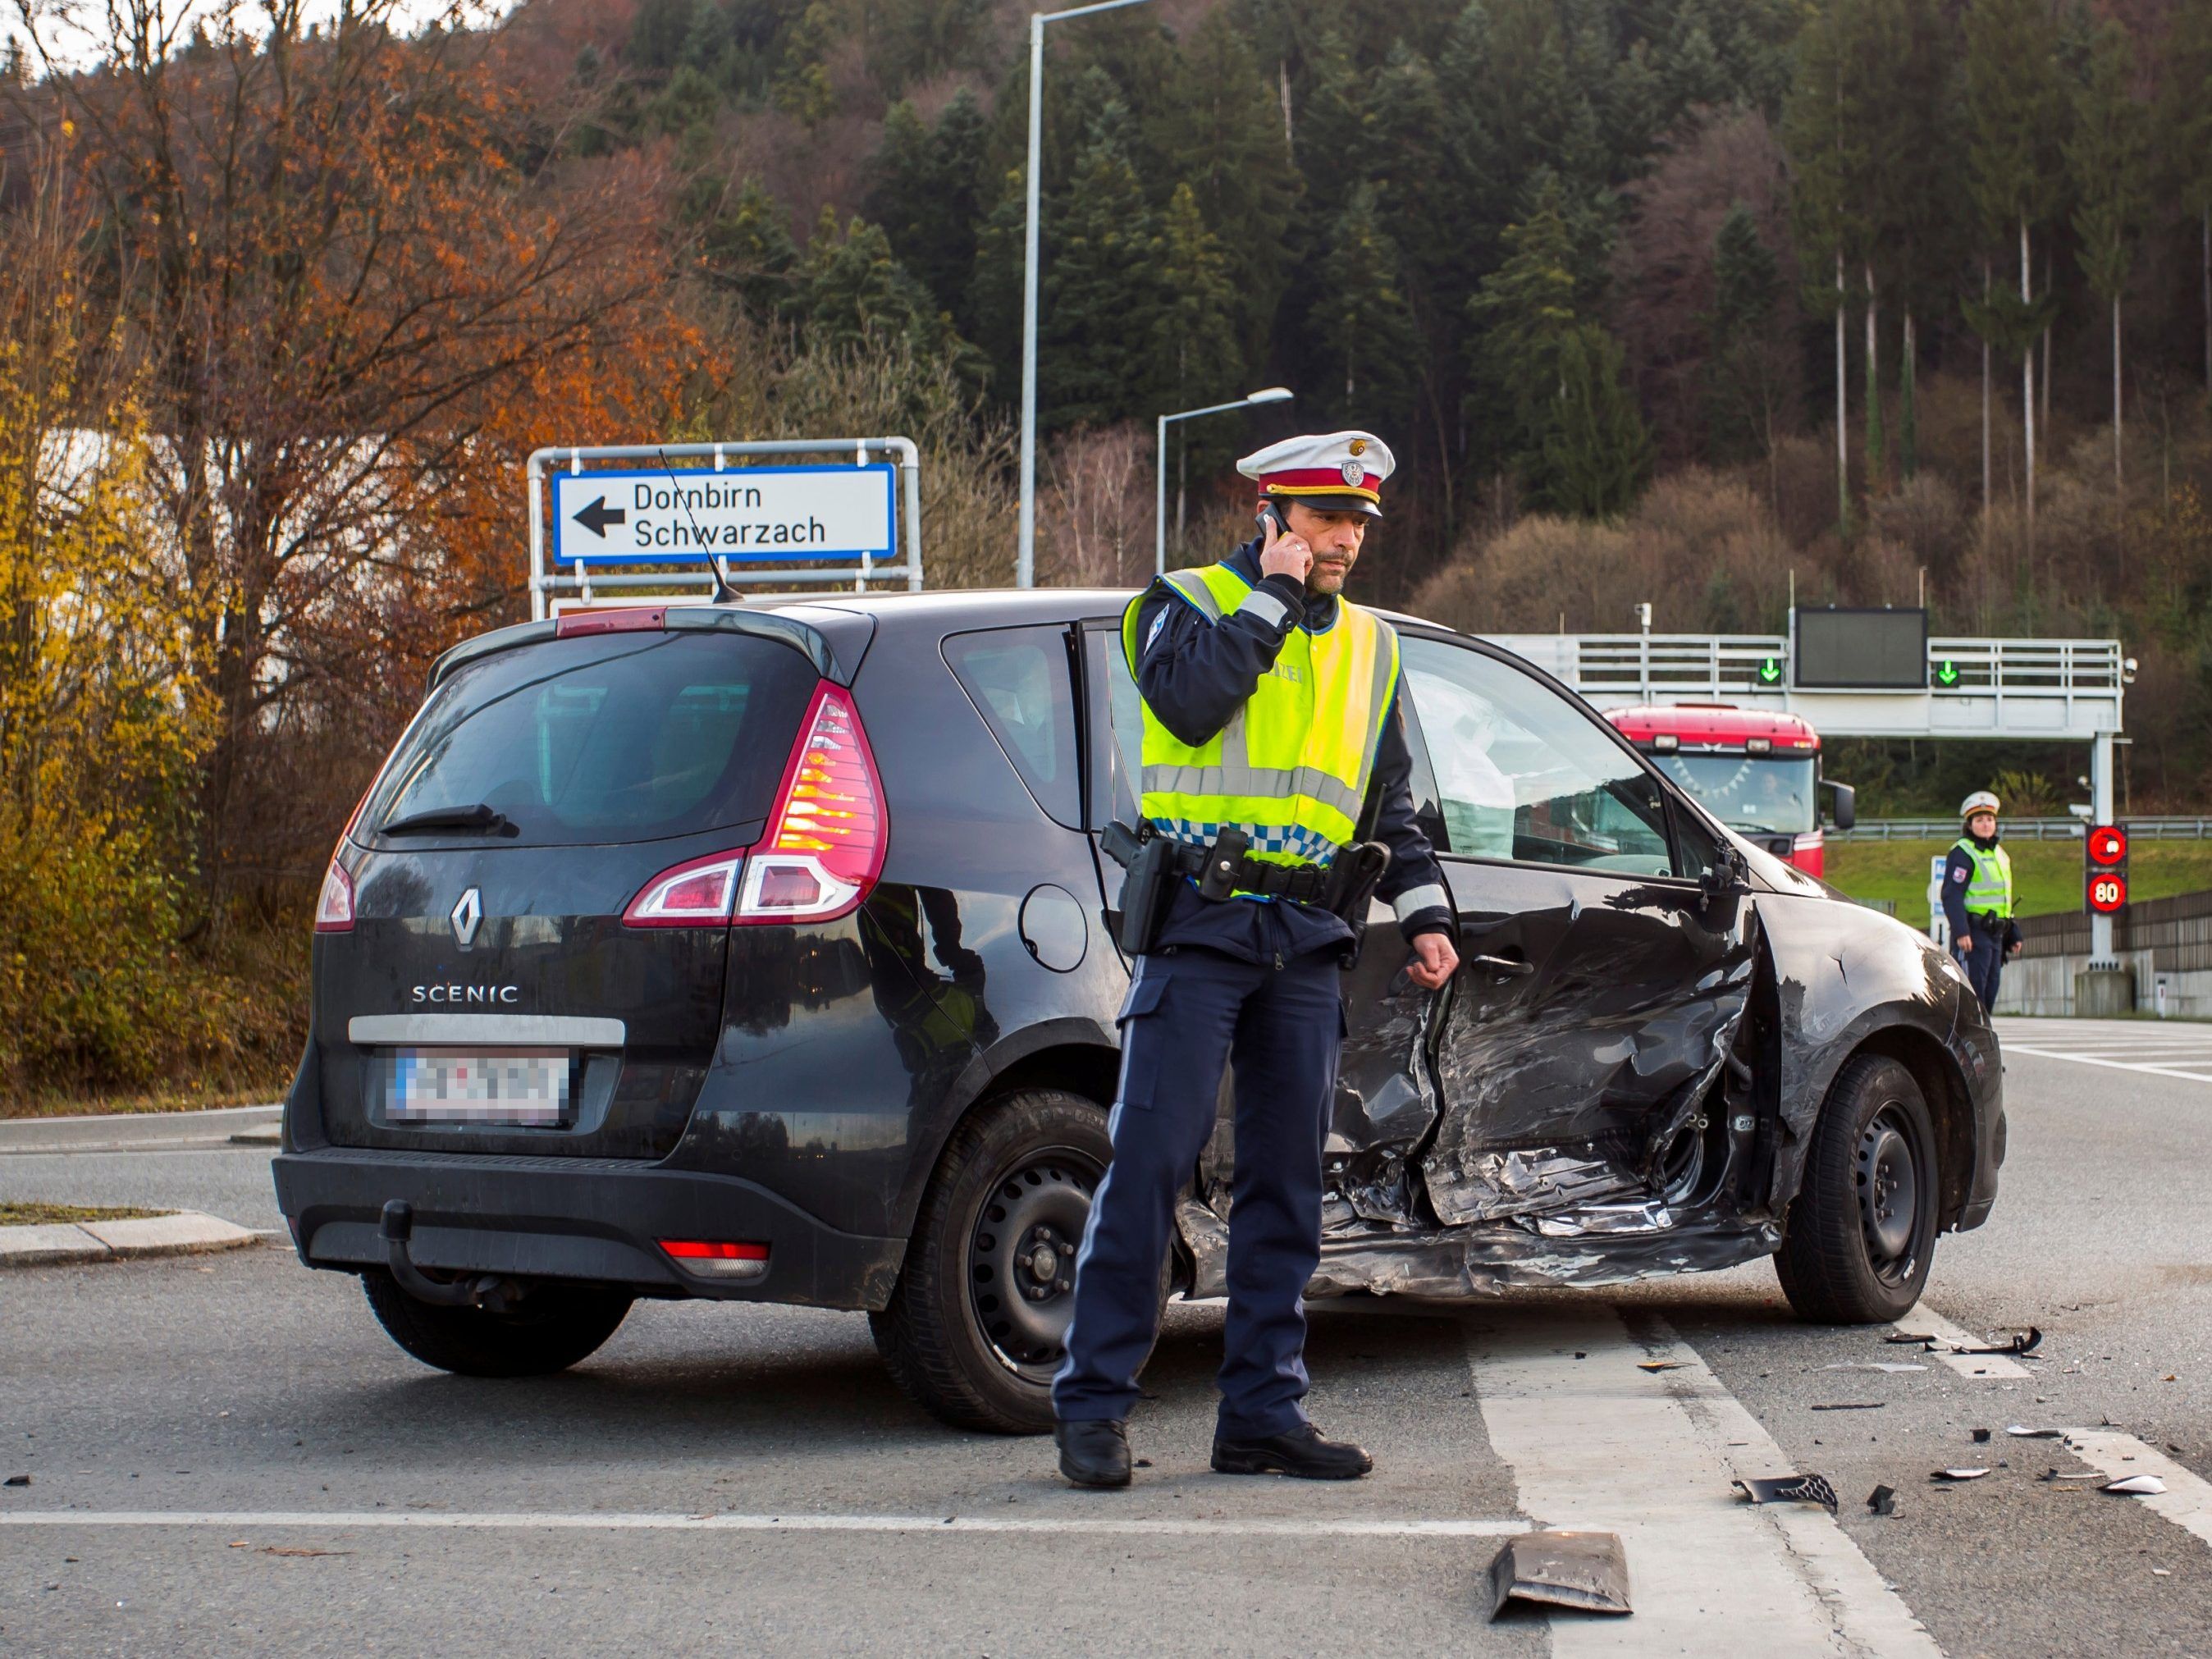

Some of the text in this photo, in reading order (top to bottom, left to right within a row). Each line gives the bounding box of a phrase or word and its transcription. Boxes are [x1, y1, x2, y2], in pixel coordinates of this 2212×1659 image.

[634, 482, 761, 510] Dornbirn
[634, 515, 825, 546] Schwarzach
[2095, 882, 2118, 903] 80
[411, 985, 519, 1003] SCENIC
